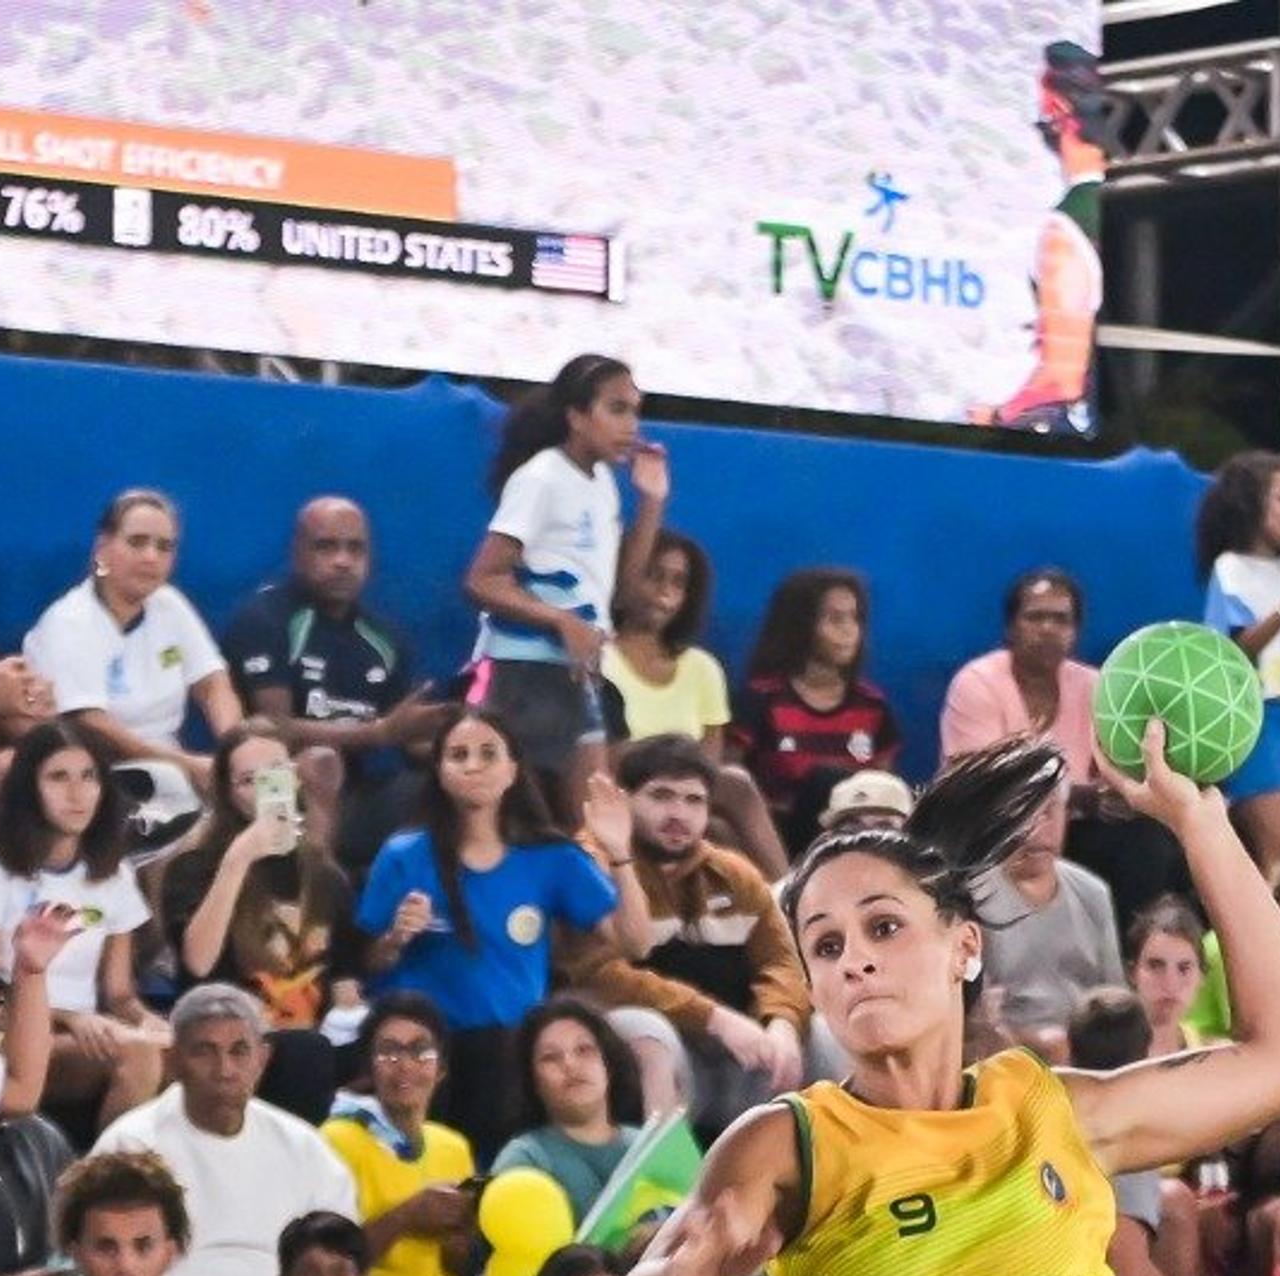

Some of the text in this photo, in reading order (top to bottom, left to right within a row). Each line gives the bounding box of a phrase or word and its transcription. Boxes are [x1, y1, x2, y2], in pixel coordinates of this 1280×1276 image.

[32, 130, 116, 171] SHOT
[121, 140, 284, 190] EFFICIENCY
[0, 183, 85, 235] 76%
[177, 203, 261, 253] 80%
[281, 217, 402, 267] UNITED
[404, 230, 514, 279] STATES
[888, 1192, 937, 1239] 9
